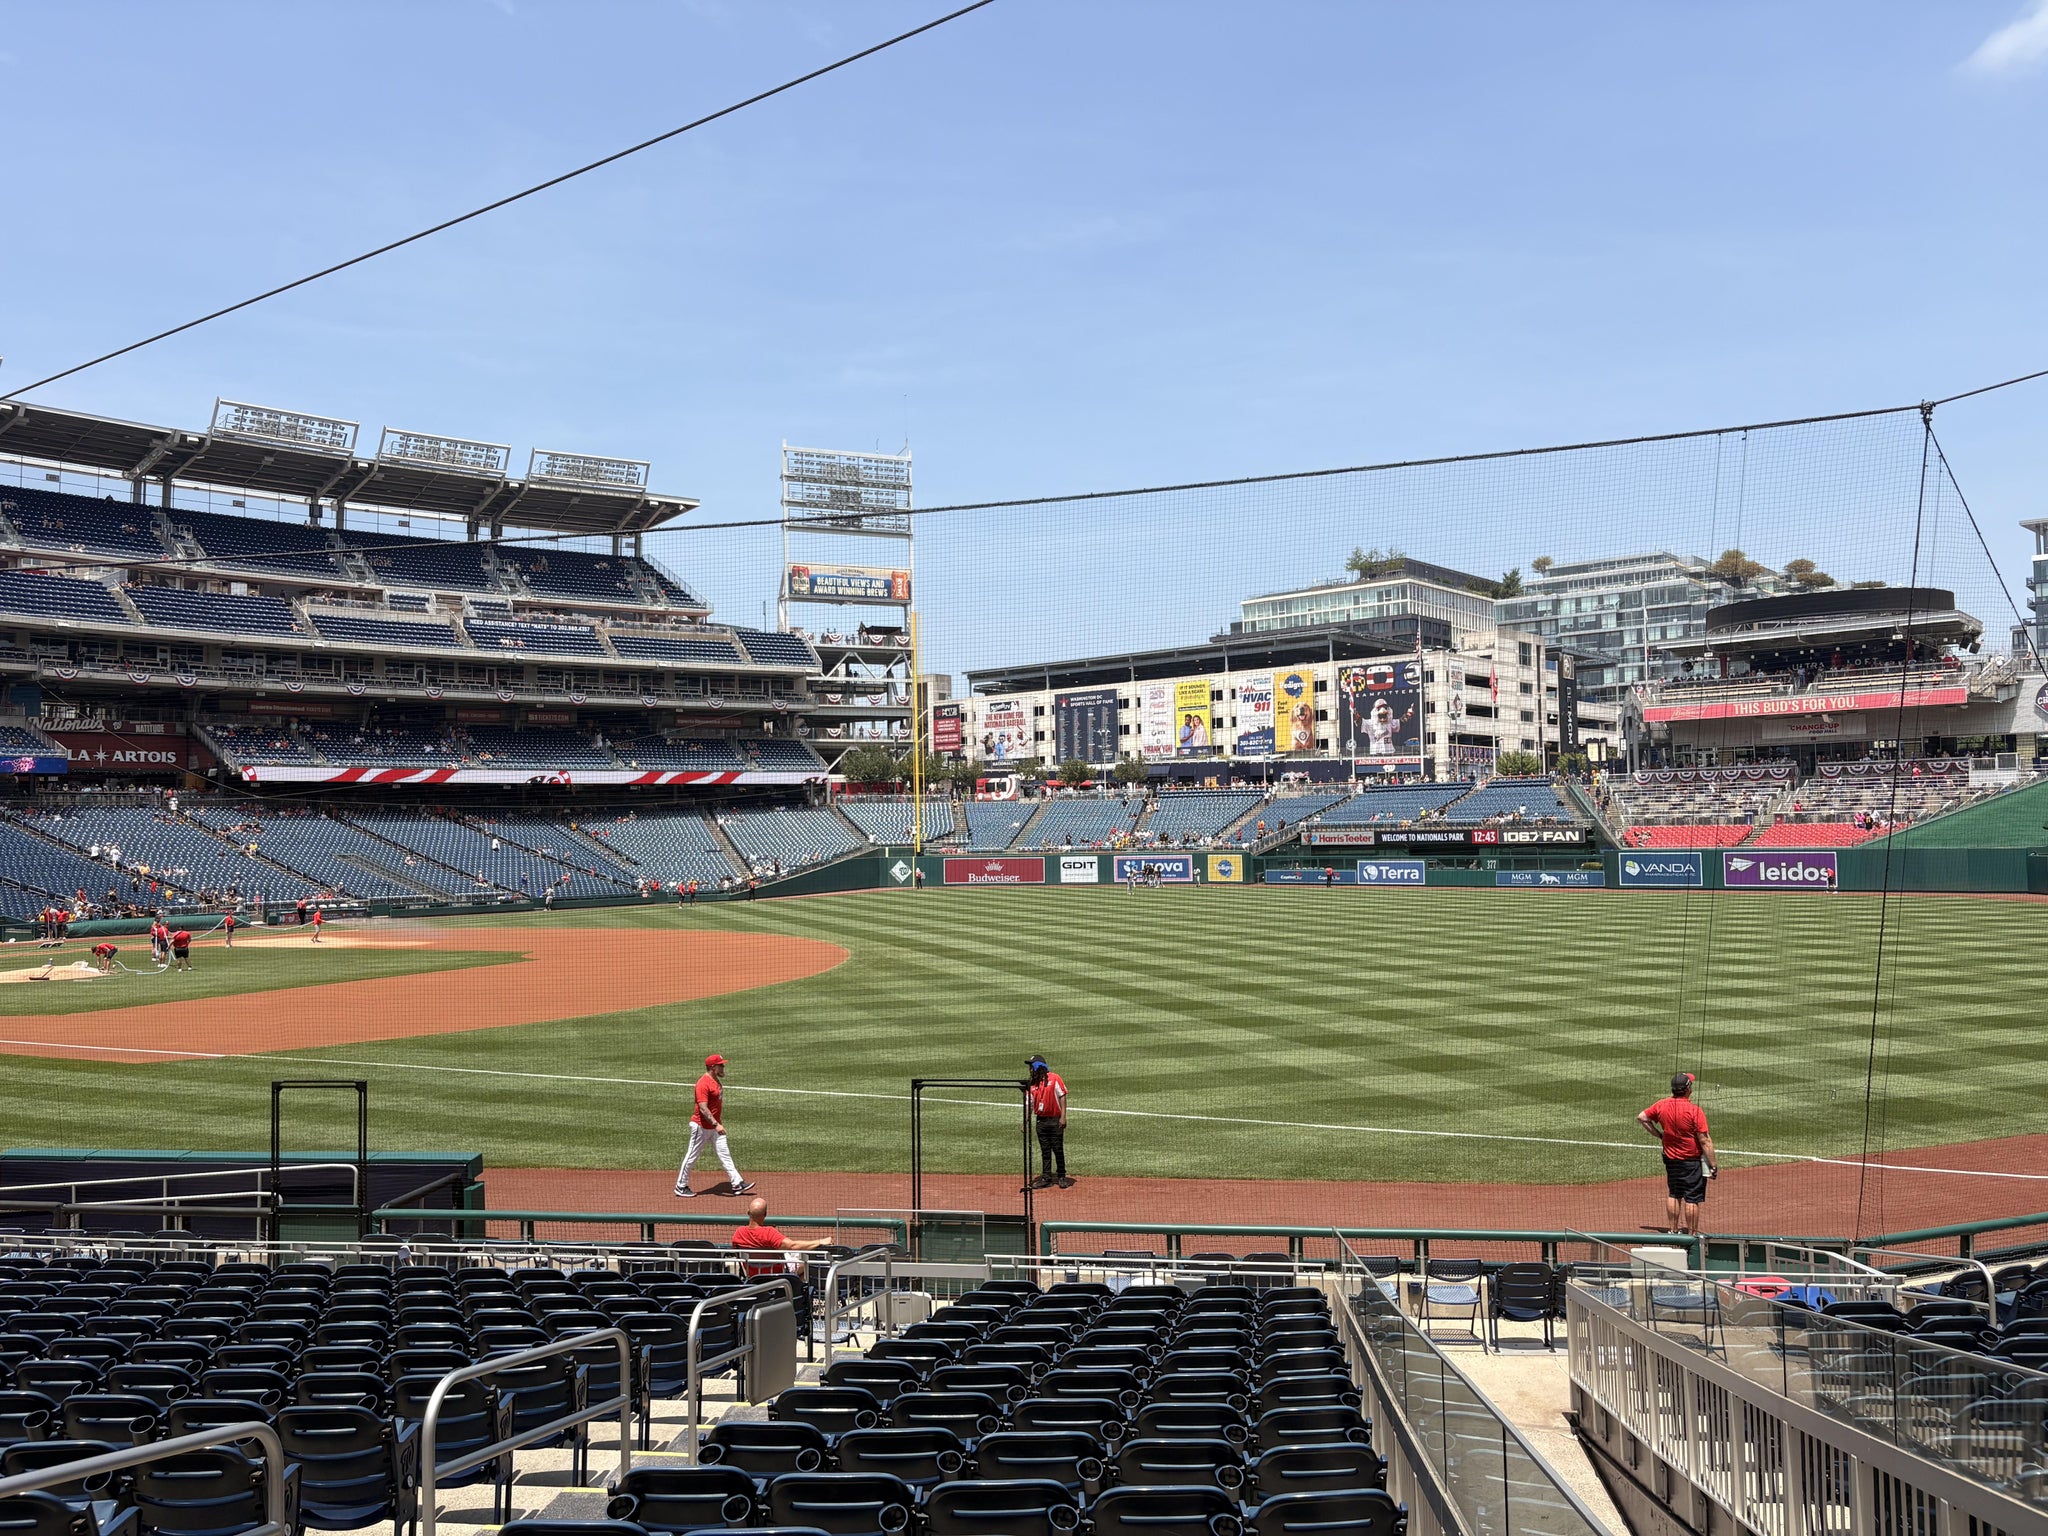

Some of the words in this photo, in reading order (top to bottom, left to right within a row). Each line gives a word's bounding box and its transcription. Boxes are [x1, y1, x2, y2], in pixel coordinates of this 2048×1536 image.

[817, 577, 849, 586] BEAUTIFUL
[851, 579, 870, 588] VIEWS
[872, 580, 884, 588] AND
[814, 586, 836, 594] AWARD
[837, 587, 865, 596] WINNING
[866, 588, 888, 597] BREWS
[484, 620, 517, 628] ASSISTANCE?
[1243, 692, 1272, 703] HVAC
[1342, 689, 1420, 699] SEAMFITTERS
[1254, 702, 1270, 712] 911
[1734, 703, 1760, 714] THIS
[1764, 700, 1799, 714] BUD'S
[1803, 699, 1826, 711] FOR
[1830, 697, 1858, 709] YOU.
[28, 717, 106, 732] Nationals
[135, 724, 165, 733] NATITUDE
[1144, 745, 1160, 754] THANK
[112, 750, 176, 763] ARTOIS
[1319, 834, 1344, 843] Harris
[1345, 834, 1372, 843] Teeter
[1382, 834, 1407, 842] WELCOME
[1408, 833, 1416, 841] TO
[1417, 833, 1448, 842] NATIONALS
[1449, 832, 1464, 841] PARK
[1474, 831, 1495, 842] 12:43
[1542, 831, 1579, 841] FAN
[1062, 861, 1096, 869] GDIT
[1486, 860, 1496, 869] 377
[1640, 863, 1695, 872] VANDA
[1379, 866, 1419, 880] Terra
[1760, 862, 1828, 881] leidos
